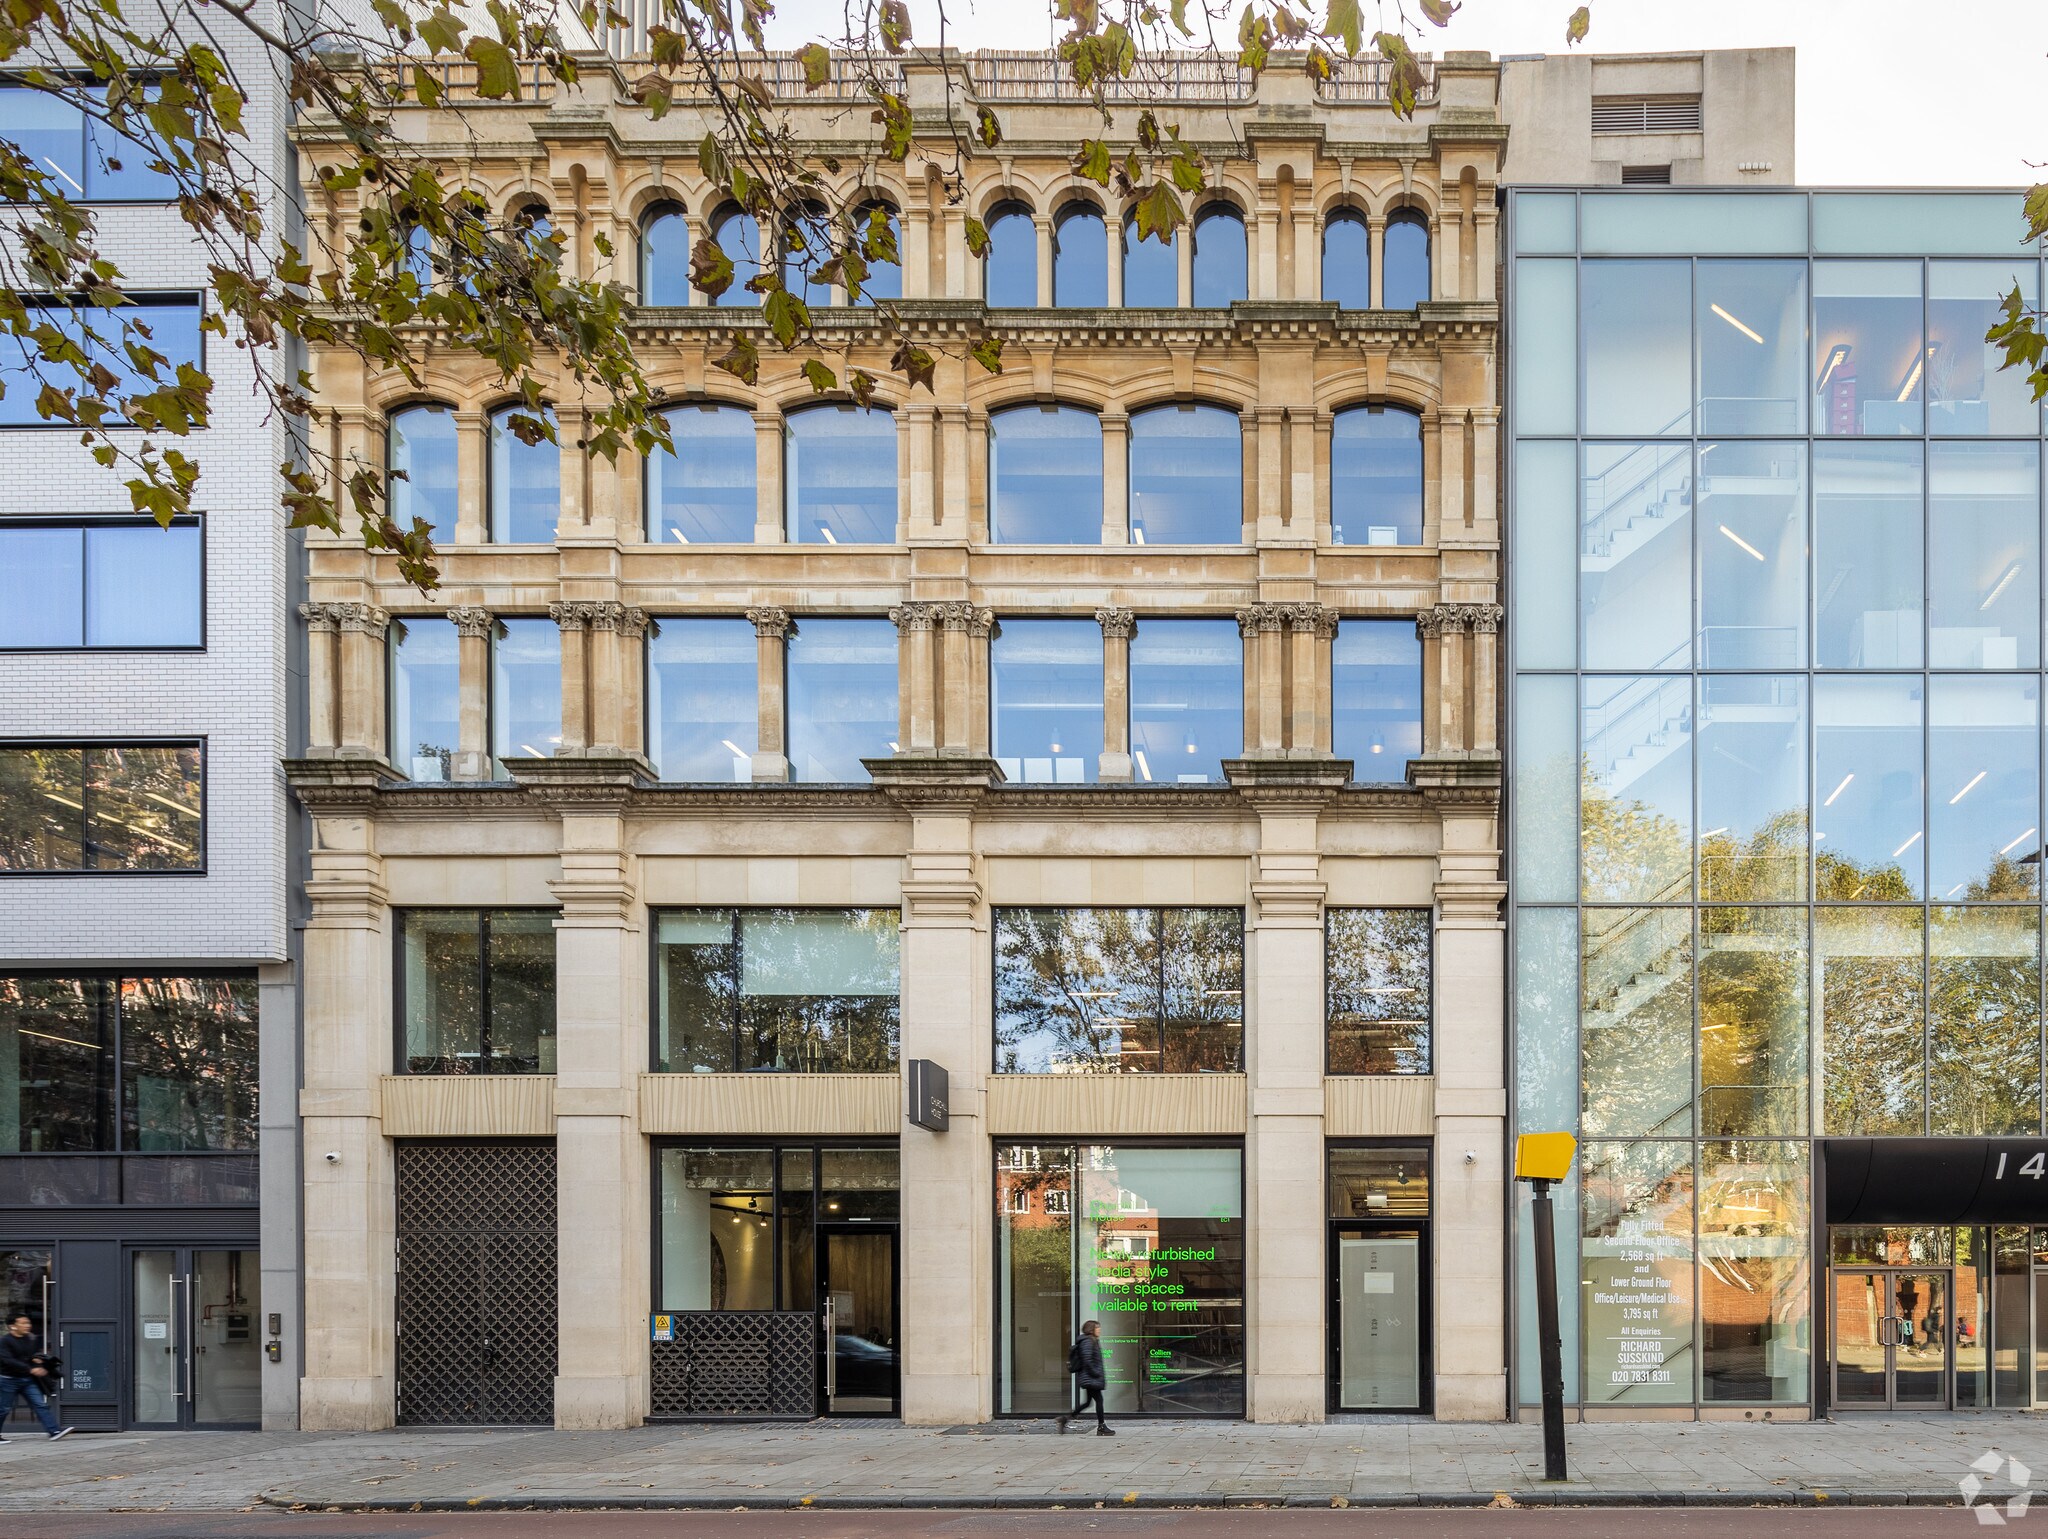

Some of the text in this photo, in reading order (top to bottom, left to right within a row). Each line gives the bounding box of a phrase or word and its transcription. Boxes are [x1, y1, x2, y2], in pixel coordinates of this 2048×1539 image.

[1621, 1220, 1664, 1231] Fully Fitted
[1604, 1234, 1680, 1246] Second Floor Office
[1090, 1246, 1215, 1262] Newly refurbished
[1620, 1250, 1664, 1263] 2,568 sq ft
[1090, 1264, 1169, 1280] media style
[1634, 1264, 1649, 1273] and
[1611, 1276, 1672, 1288] Lower Ground Floor
[1090, 1281, 1184, 1297] office spaces
[1594, 1292, 1666, 1304] Office/Leisure/Medical
[1090, 1298, 1199, 1311] available to rent
[1623, 1308, 1659, 1320] 3,795 sq ft
[1621, 1326, 1661, 1337] All Enquiries
[1621, 1341, 1661, 1352] RICHARD
[1617, 1352, 1664, 1363] SUSSKIND
[1612, 1370, 1670, 1382] 020 7831 8311
